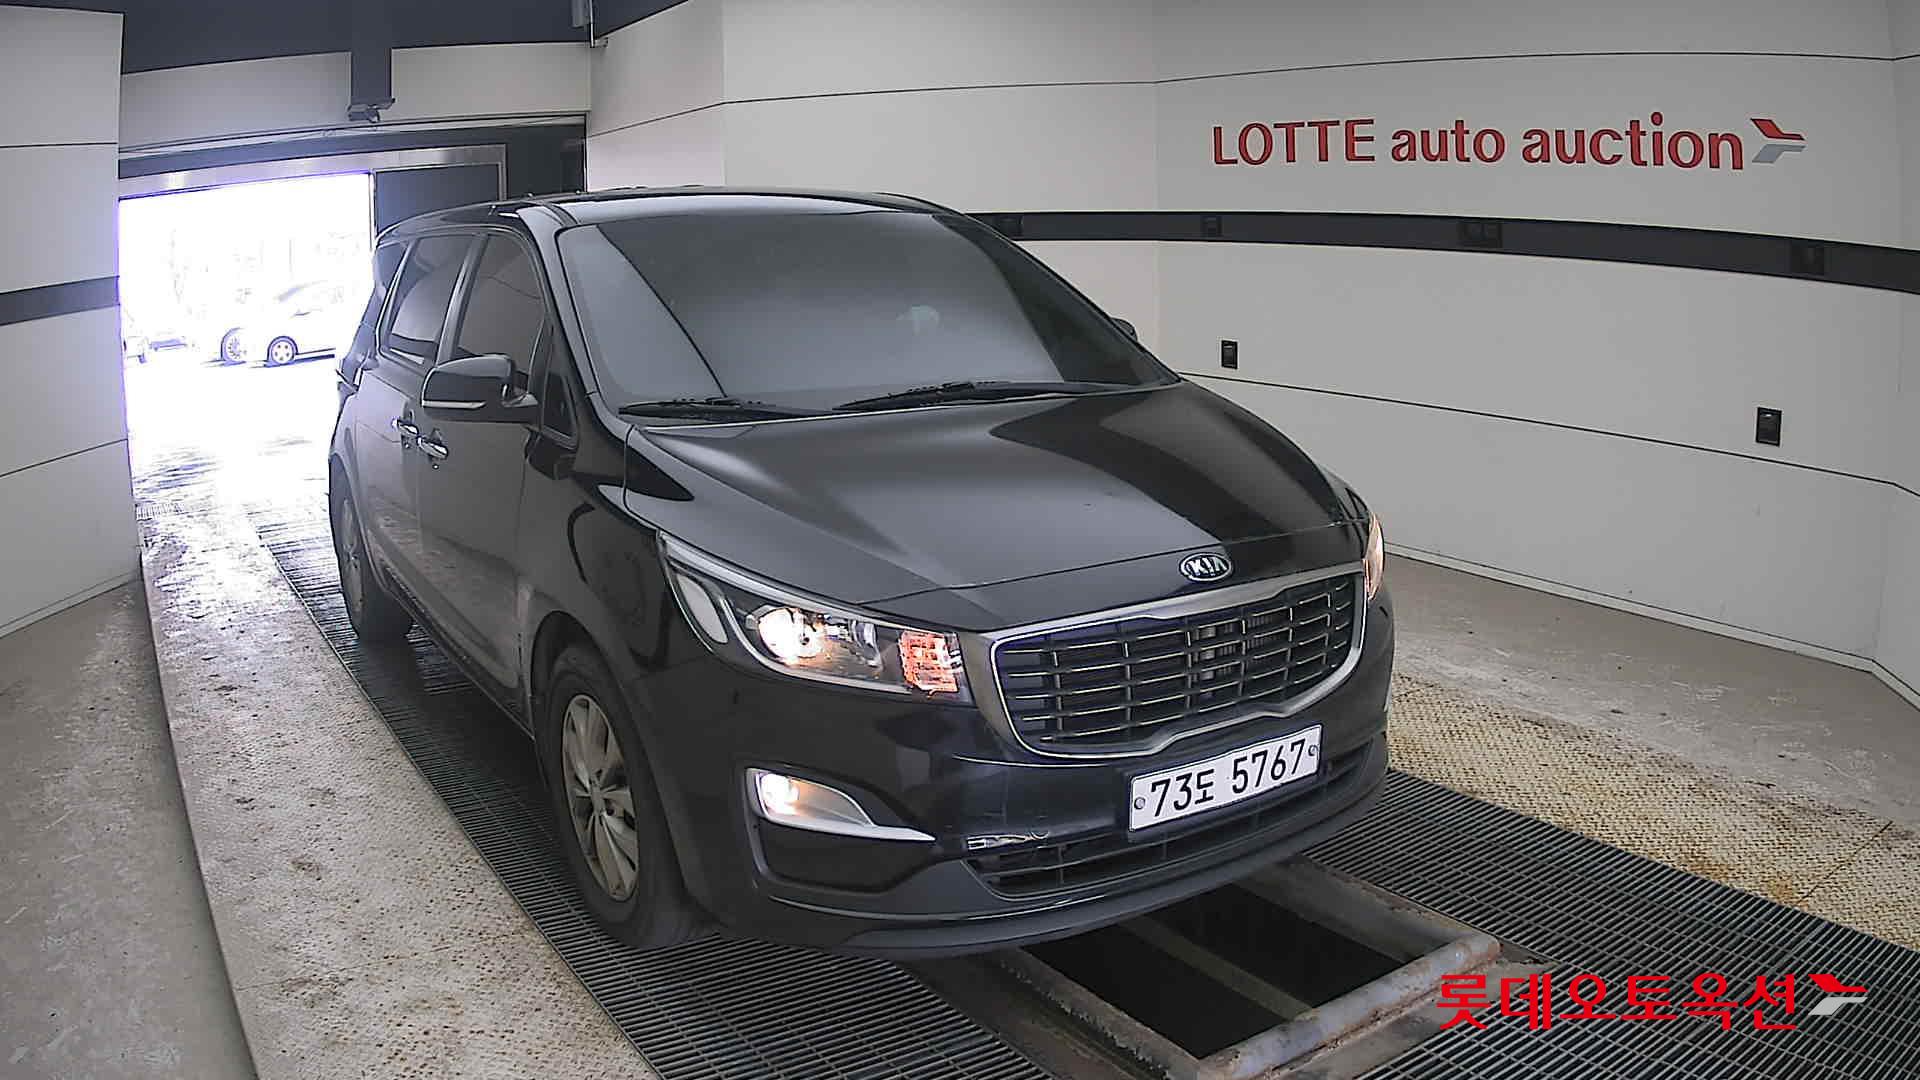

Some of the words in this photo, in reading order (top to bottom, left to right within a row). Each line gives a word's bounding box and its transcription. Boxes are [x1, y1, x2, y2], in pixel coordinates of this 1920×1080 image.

[1213, 120, 1375, 165] LOTTE
[1391, 120, 1506, 163] auto
[1522, 112, 1744, 170] auction
[1186, 556, 1228, 577] KIA
[1150, 768, 1215, 817] 73도
[1232, 738, 1306, 794] 5767
